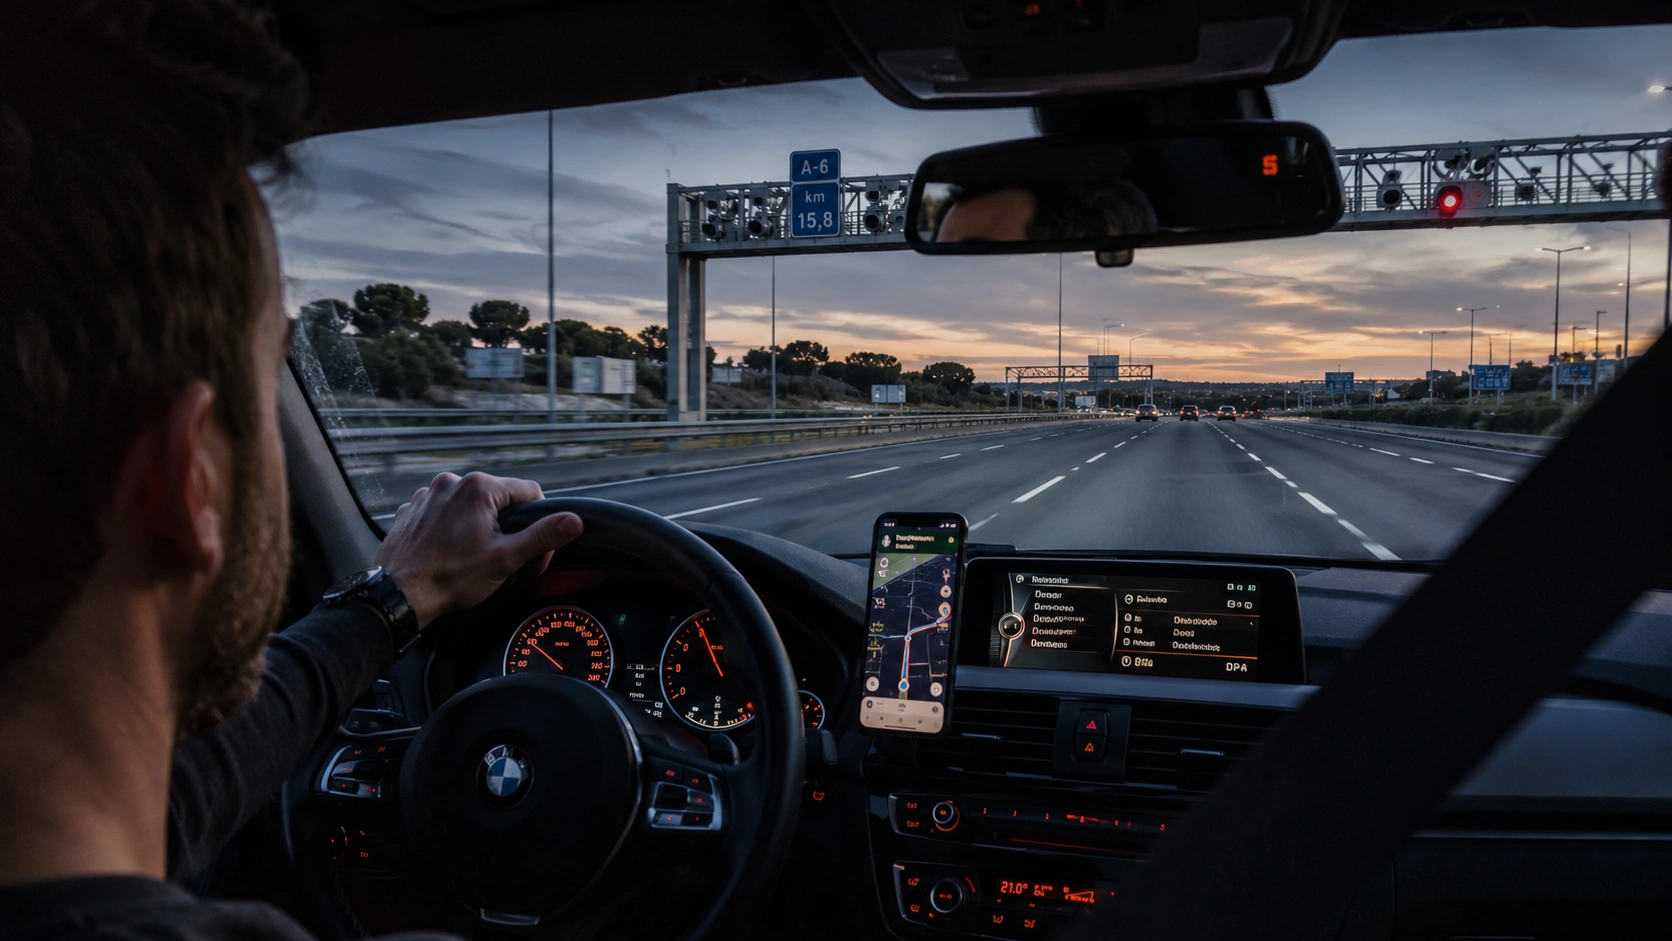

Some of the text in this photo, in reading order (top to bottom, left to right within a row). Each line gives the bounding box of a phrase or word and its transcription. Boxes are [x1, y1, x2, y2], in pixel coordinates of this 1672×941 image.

[801, 158, 829, 175] A-6
[805, 190, 825, 203] km
[798, 211, 833, 232] 15,8
[1225, 662, 1248, 673] DPA
